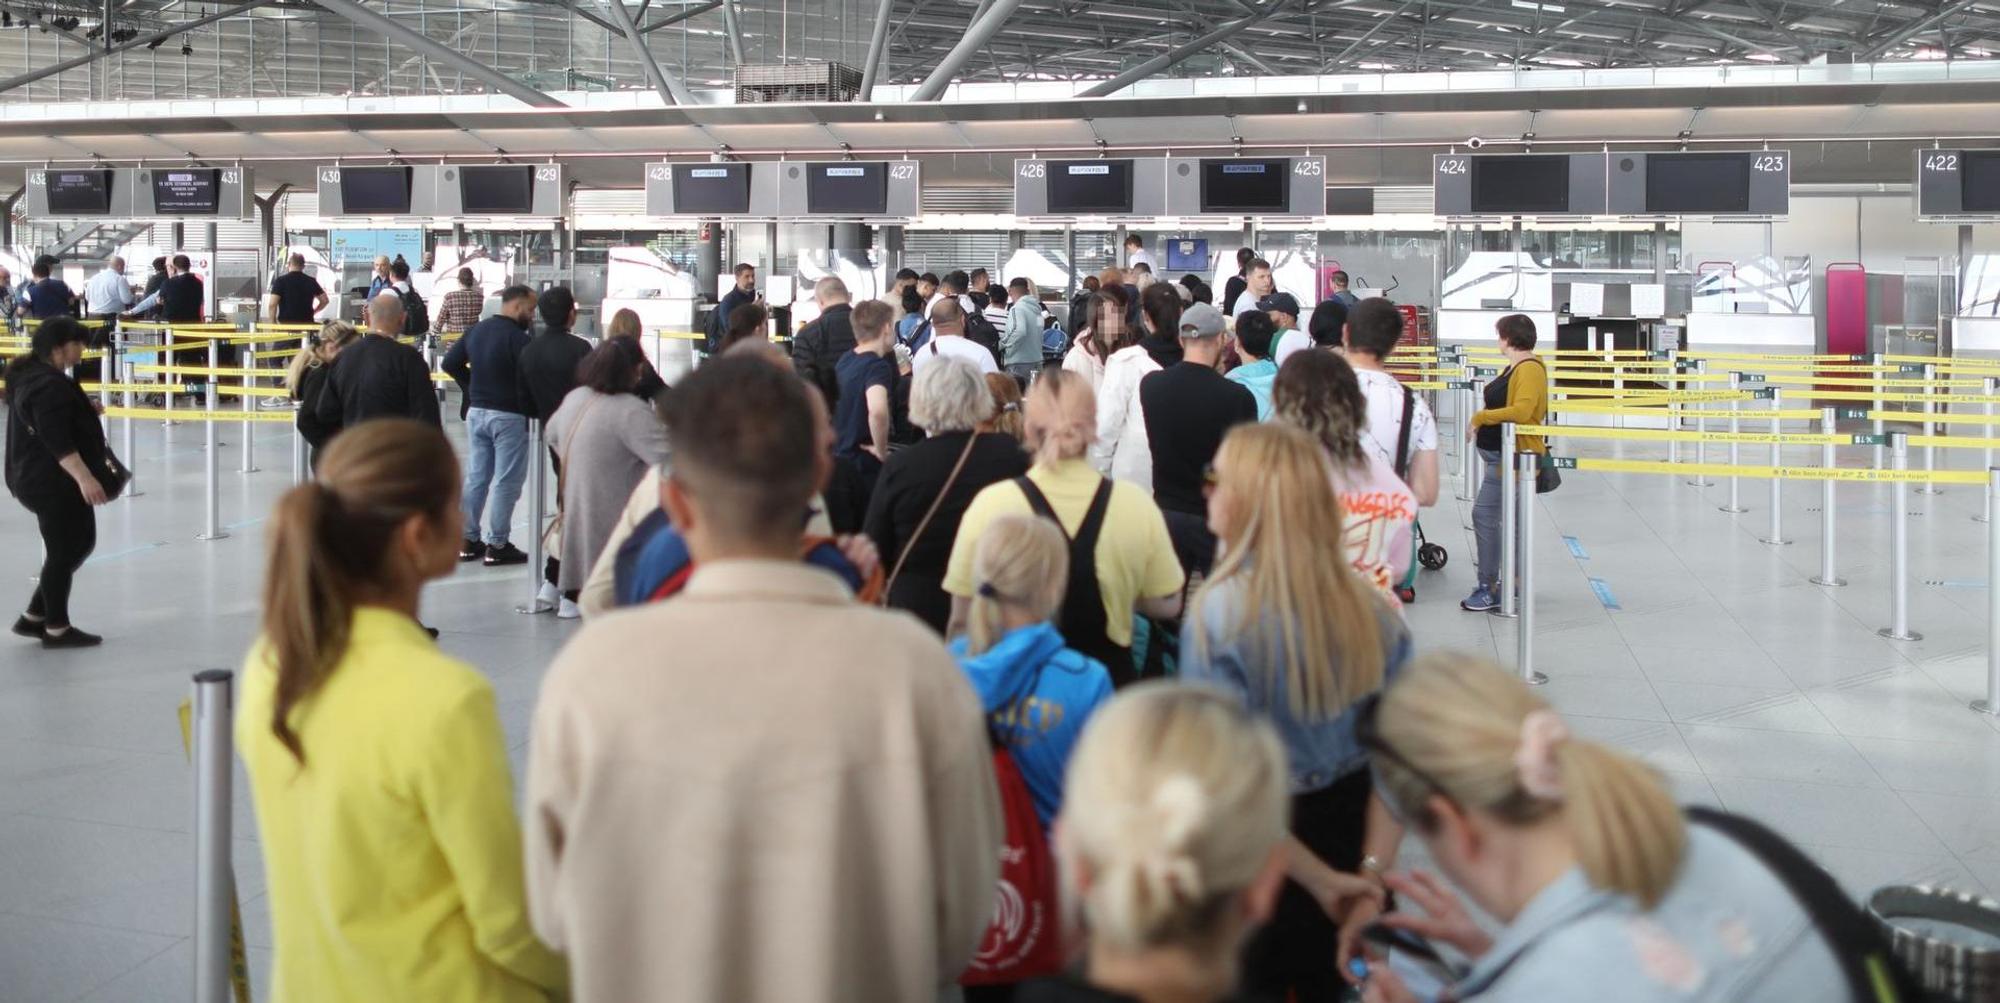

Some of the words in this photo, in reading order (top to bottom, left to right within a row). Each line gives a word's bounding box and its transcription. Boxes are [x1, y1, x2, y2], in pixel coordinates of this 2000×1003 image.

[1294, 161, 1321, 176] 425
[1439, 159, 1466, 174] 424
[1753, 156, 1784, 171] 423
[1925, 155, 1957, 171] 422
[221, 171, 239, 184] 431
[321, 170, 341, 183] 430
[536, 168, 557, 181] 429
[650, 167, 672, 180] 428
[891, 165, 914, 179] 427
[1020, 164, 1044, 178] 426
[30, 172, 47, 185] 432
